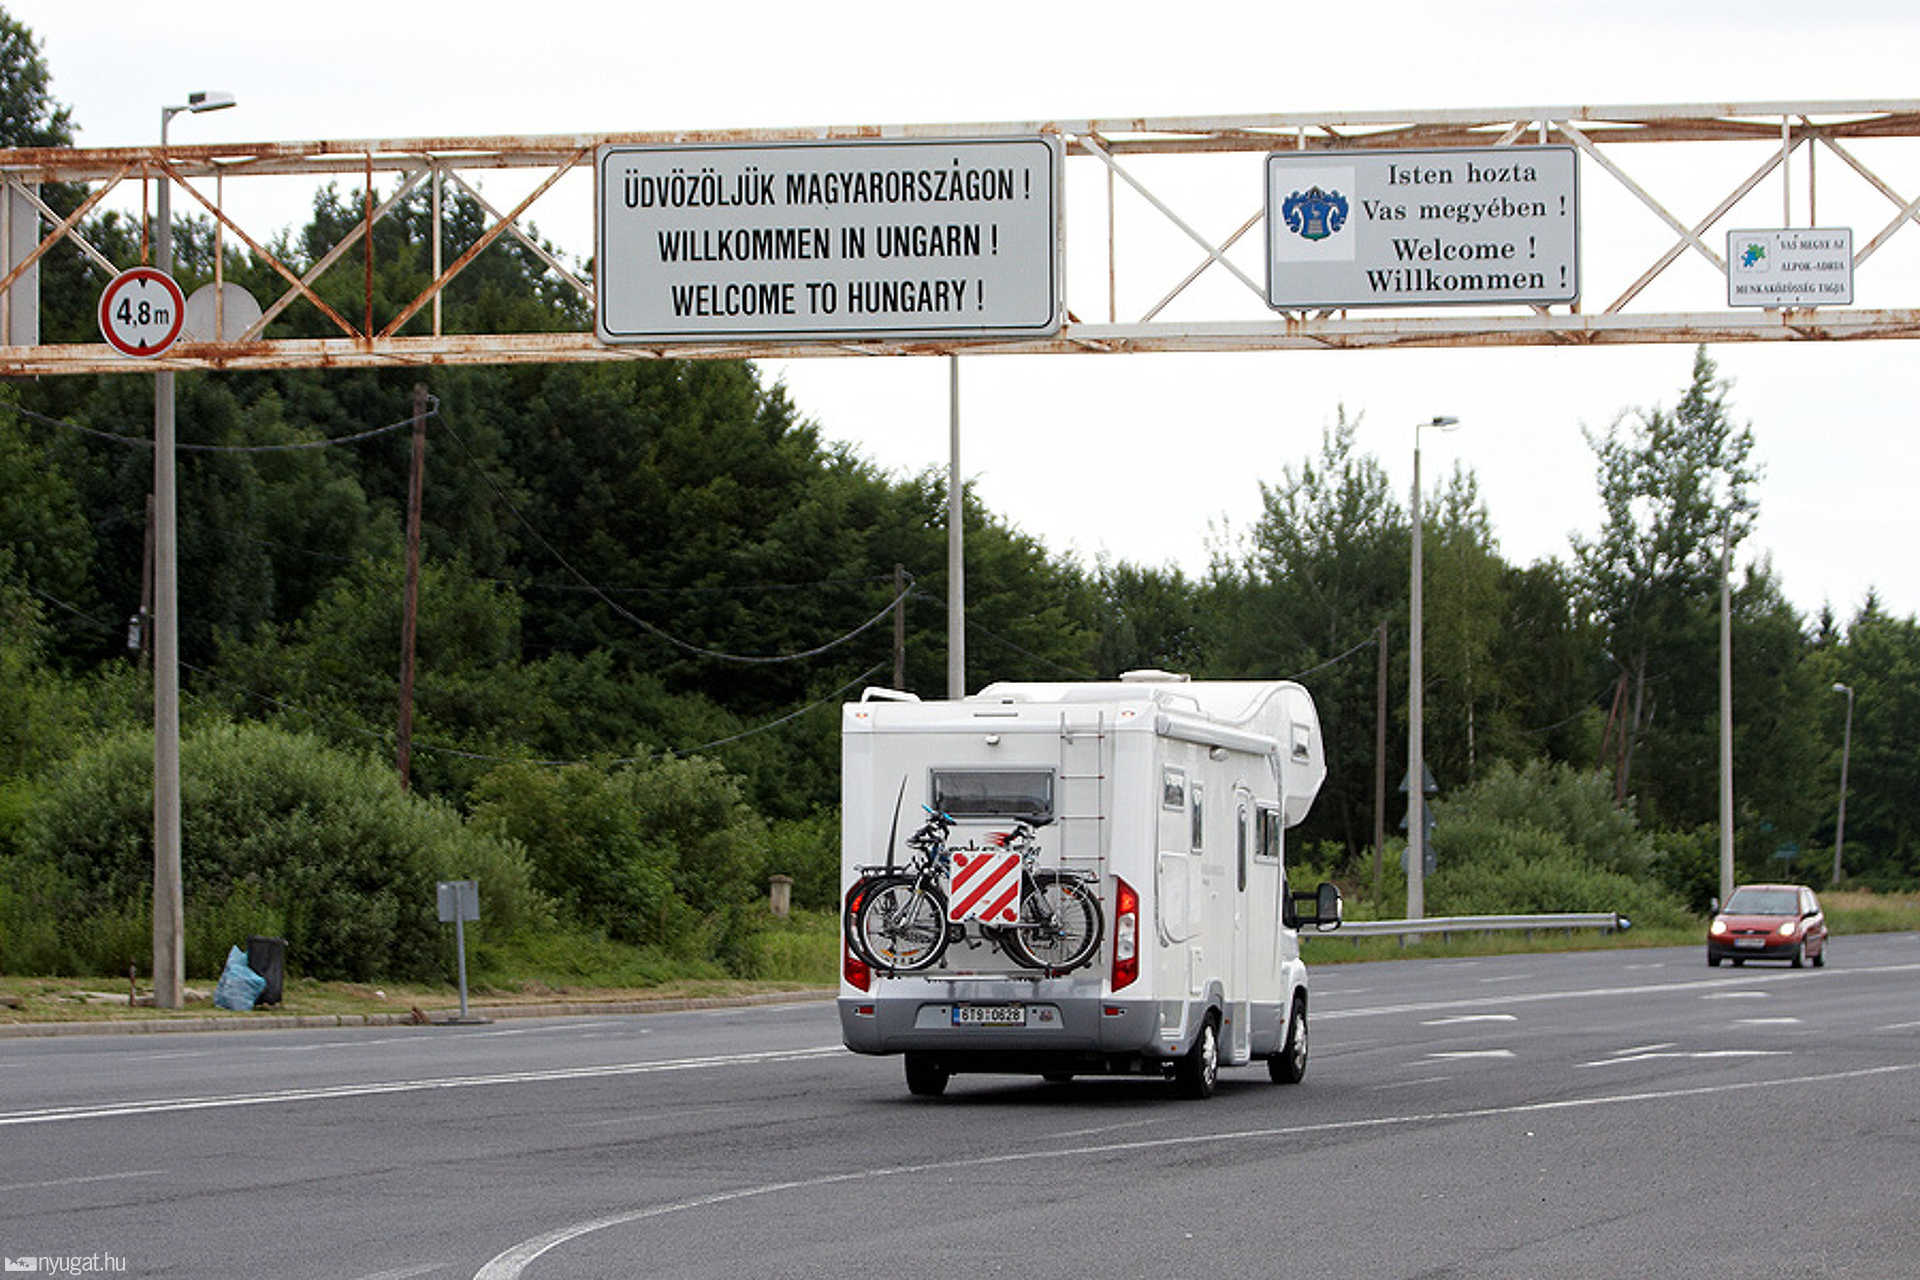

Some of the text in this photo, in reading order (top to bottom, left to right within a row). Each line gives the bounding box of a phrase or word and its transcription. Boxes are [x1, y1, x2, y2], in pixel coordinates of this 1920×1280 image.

[624, 166, 776, 209] ÜDVÖZÖLJÜK
[786, 157, 1014, 206] MAGYARORSZÁGON
[1388, 162, 1537, 185] Isten hozta
[1361, 200, 1406, 221] Vas
[1420, 196, 1546, 223] megyében
[658, 227, 830, 263] WILLKOMMEN
[841, 226, 865, 259] IN
[876, 224, 980, 259] UNGARN
[1392, 238, 1515, 261] Welcome
[1366, 268, 1544, 292] Willkommen
[671, 283, 796, 317] WELCOME
[805, 282, 837, 315] TO
[848, 279, 967, 314] HUNGARY
